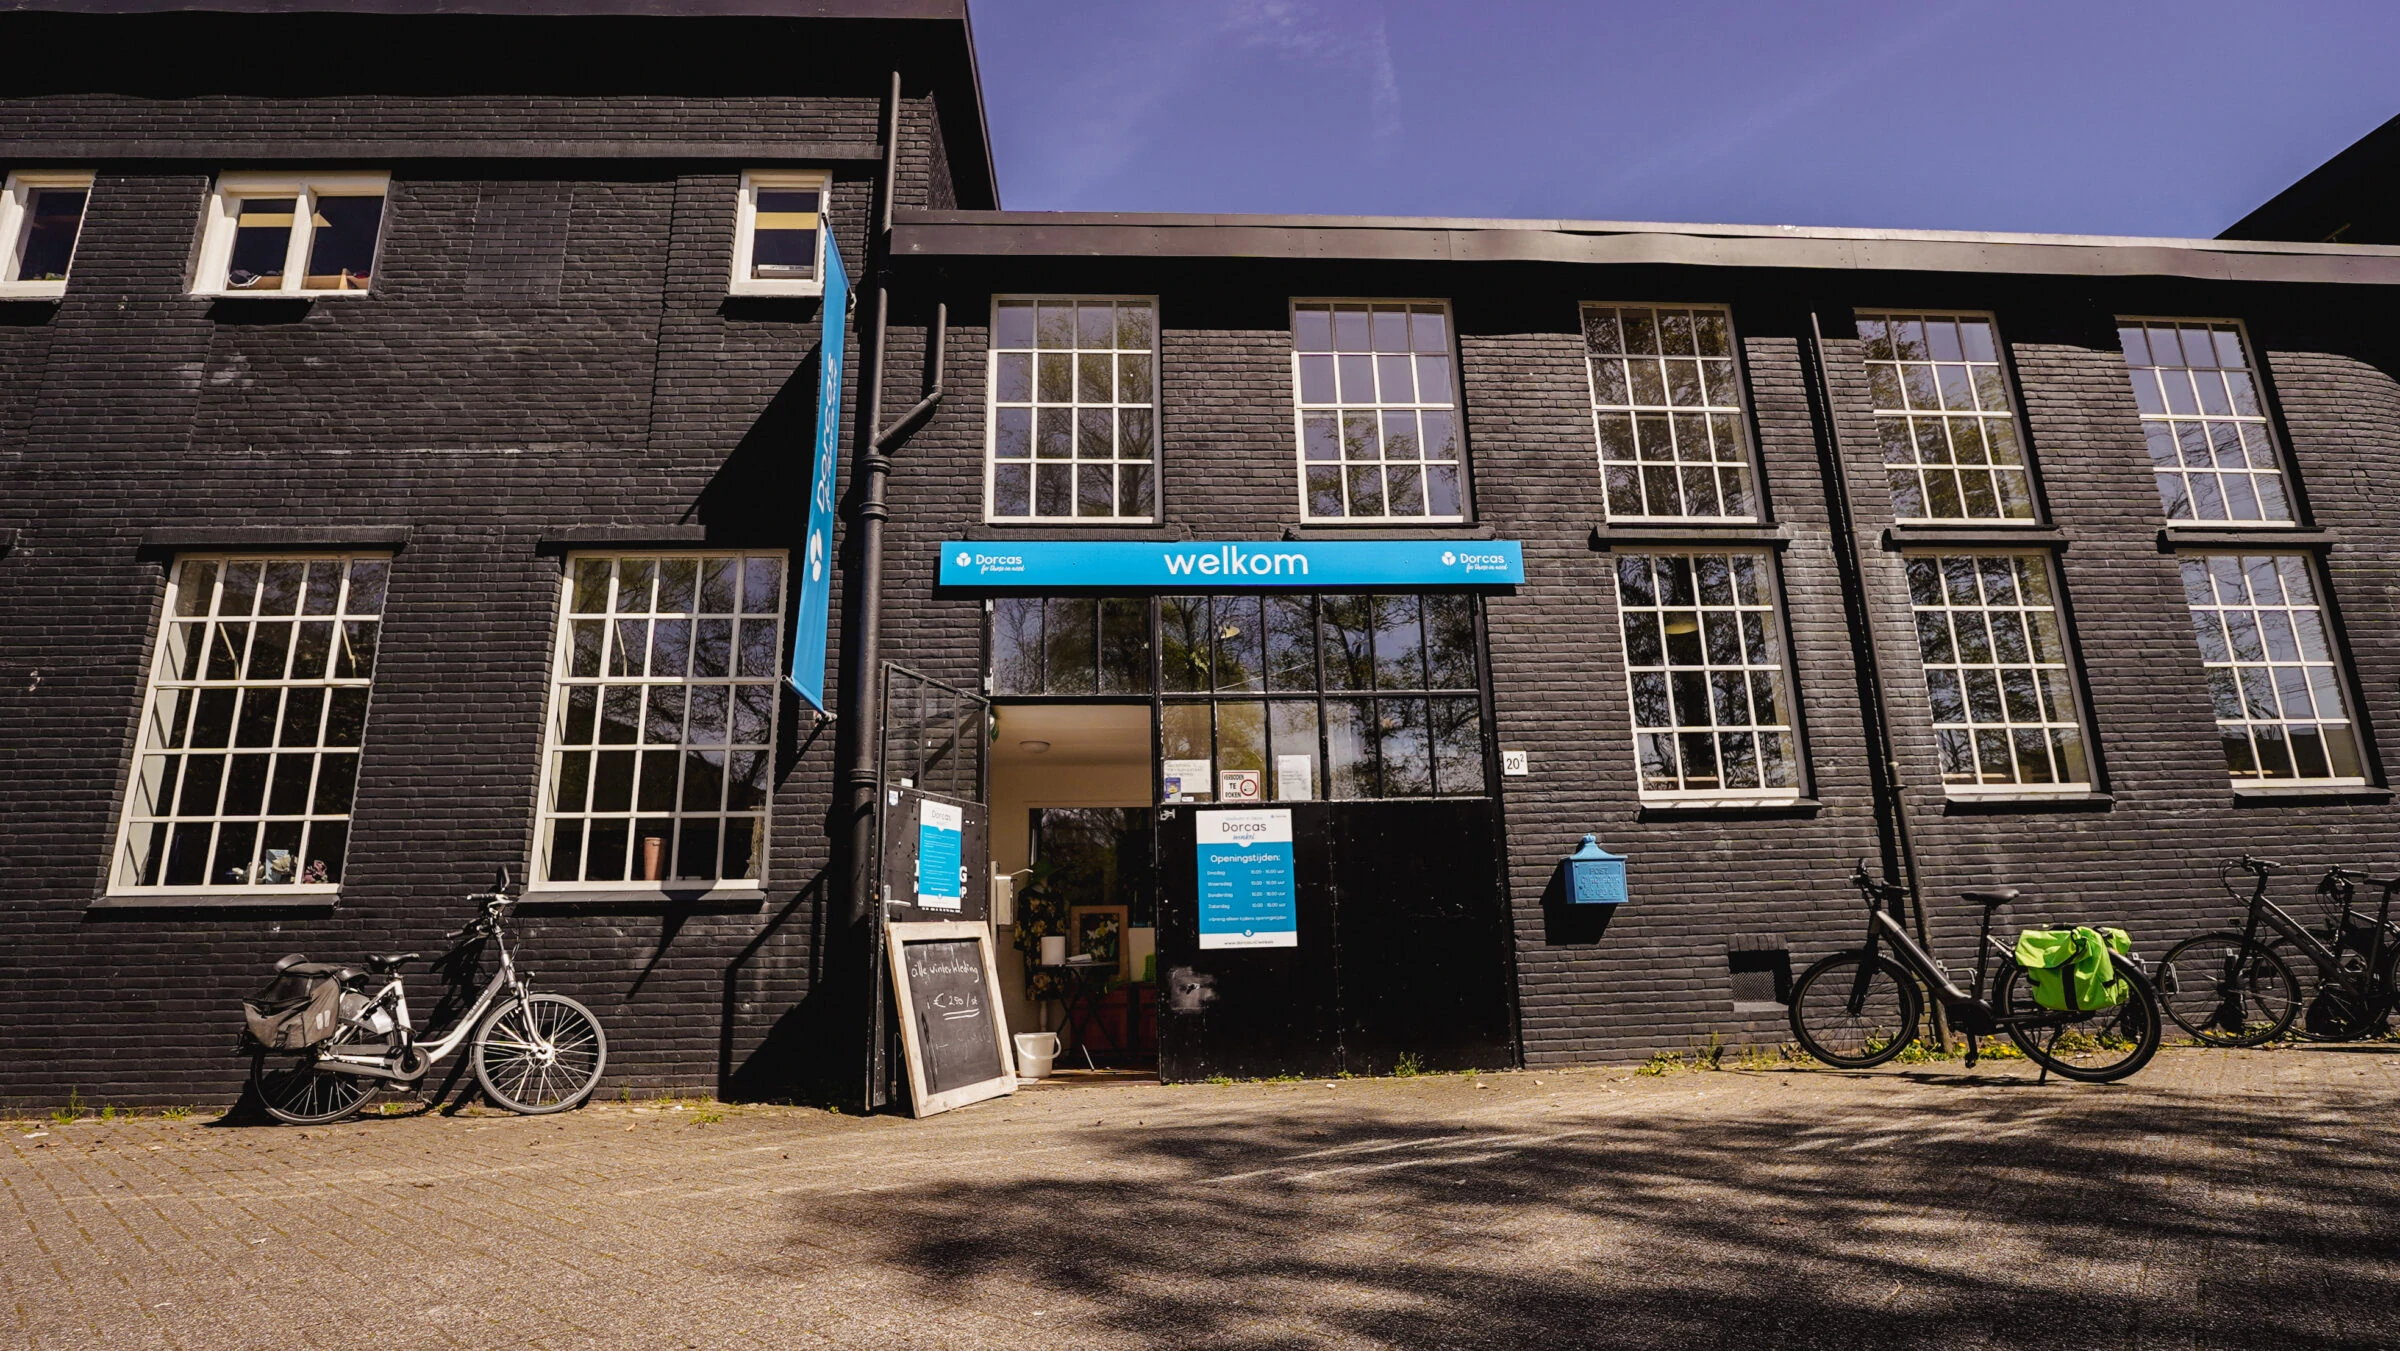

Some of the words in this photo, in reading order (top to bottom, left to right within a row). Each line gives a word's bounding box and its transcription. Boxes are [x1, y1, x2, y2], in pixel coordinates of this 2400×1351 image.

[817, 352, 834, 514] Dorcas
[975, 553, 1023, 565] Dorcas
[1163, 545, 1309, 575] welkom
[1460, 553, 1505, 564] Dorcas
[1222, 822, 1267, 832] Dorcas
[1210, 853, 1281, 864] Openingstijden:
